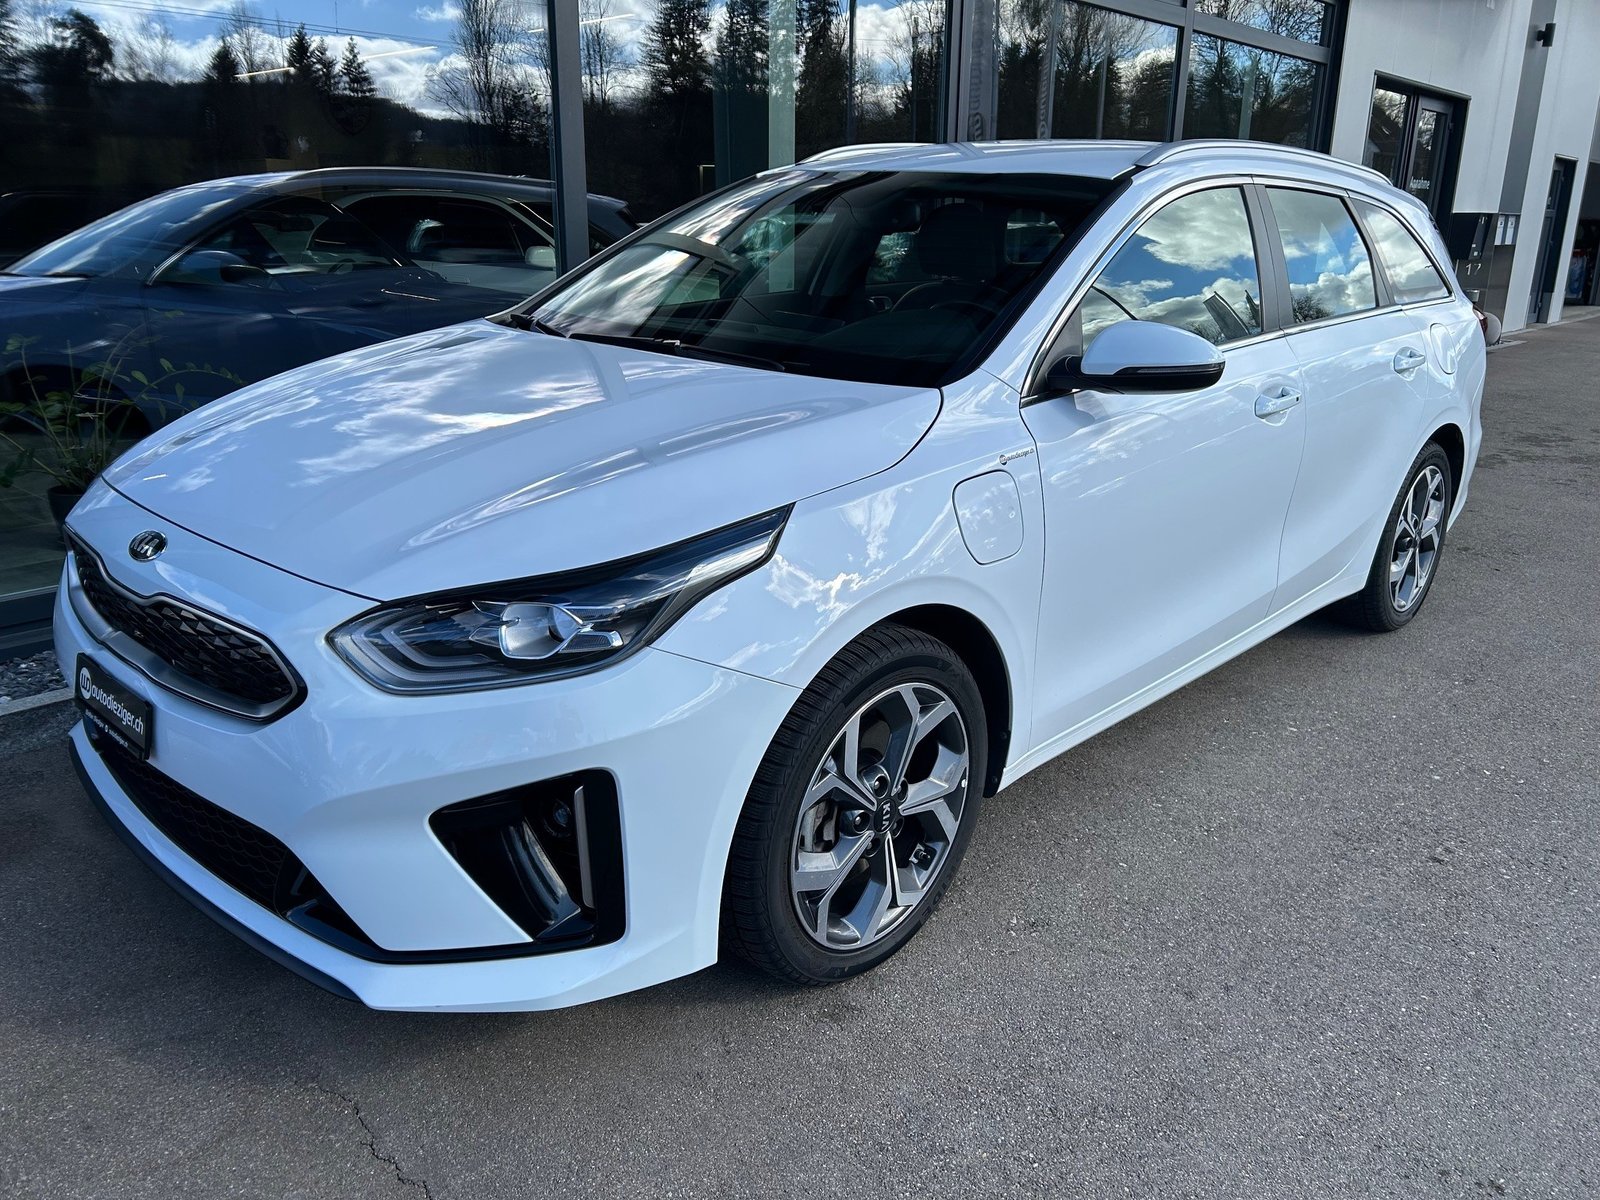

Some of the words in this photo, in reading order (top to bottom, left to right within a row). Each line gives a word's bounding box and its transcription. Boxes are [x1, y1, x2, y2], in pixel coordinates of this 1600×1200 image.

[1465, 263, 1482, 276] 17
[91, 684, 145, 735] autodieziger.ch
[881, 802, 891, 831] KIA
